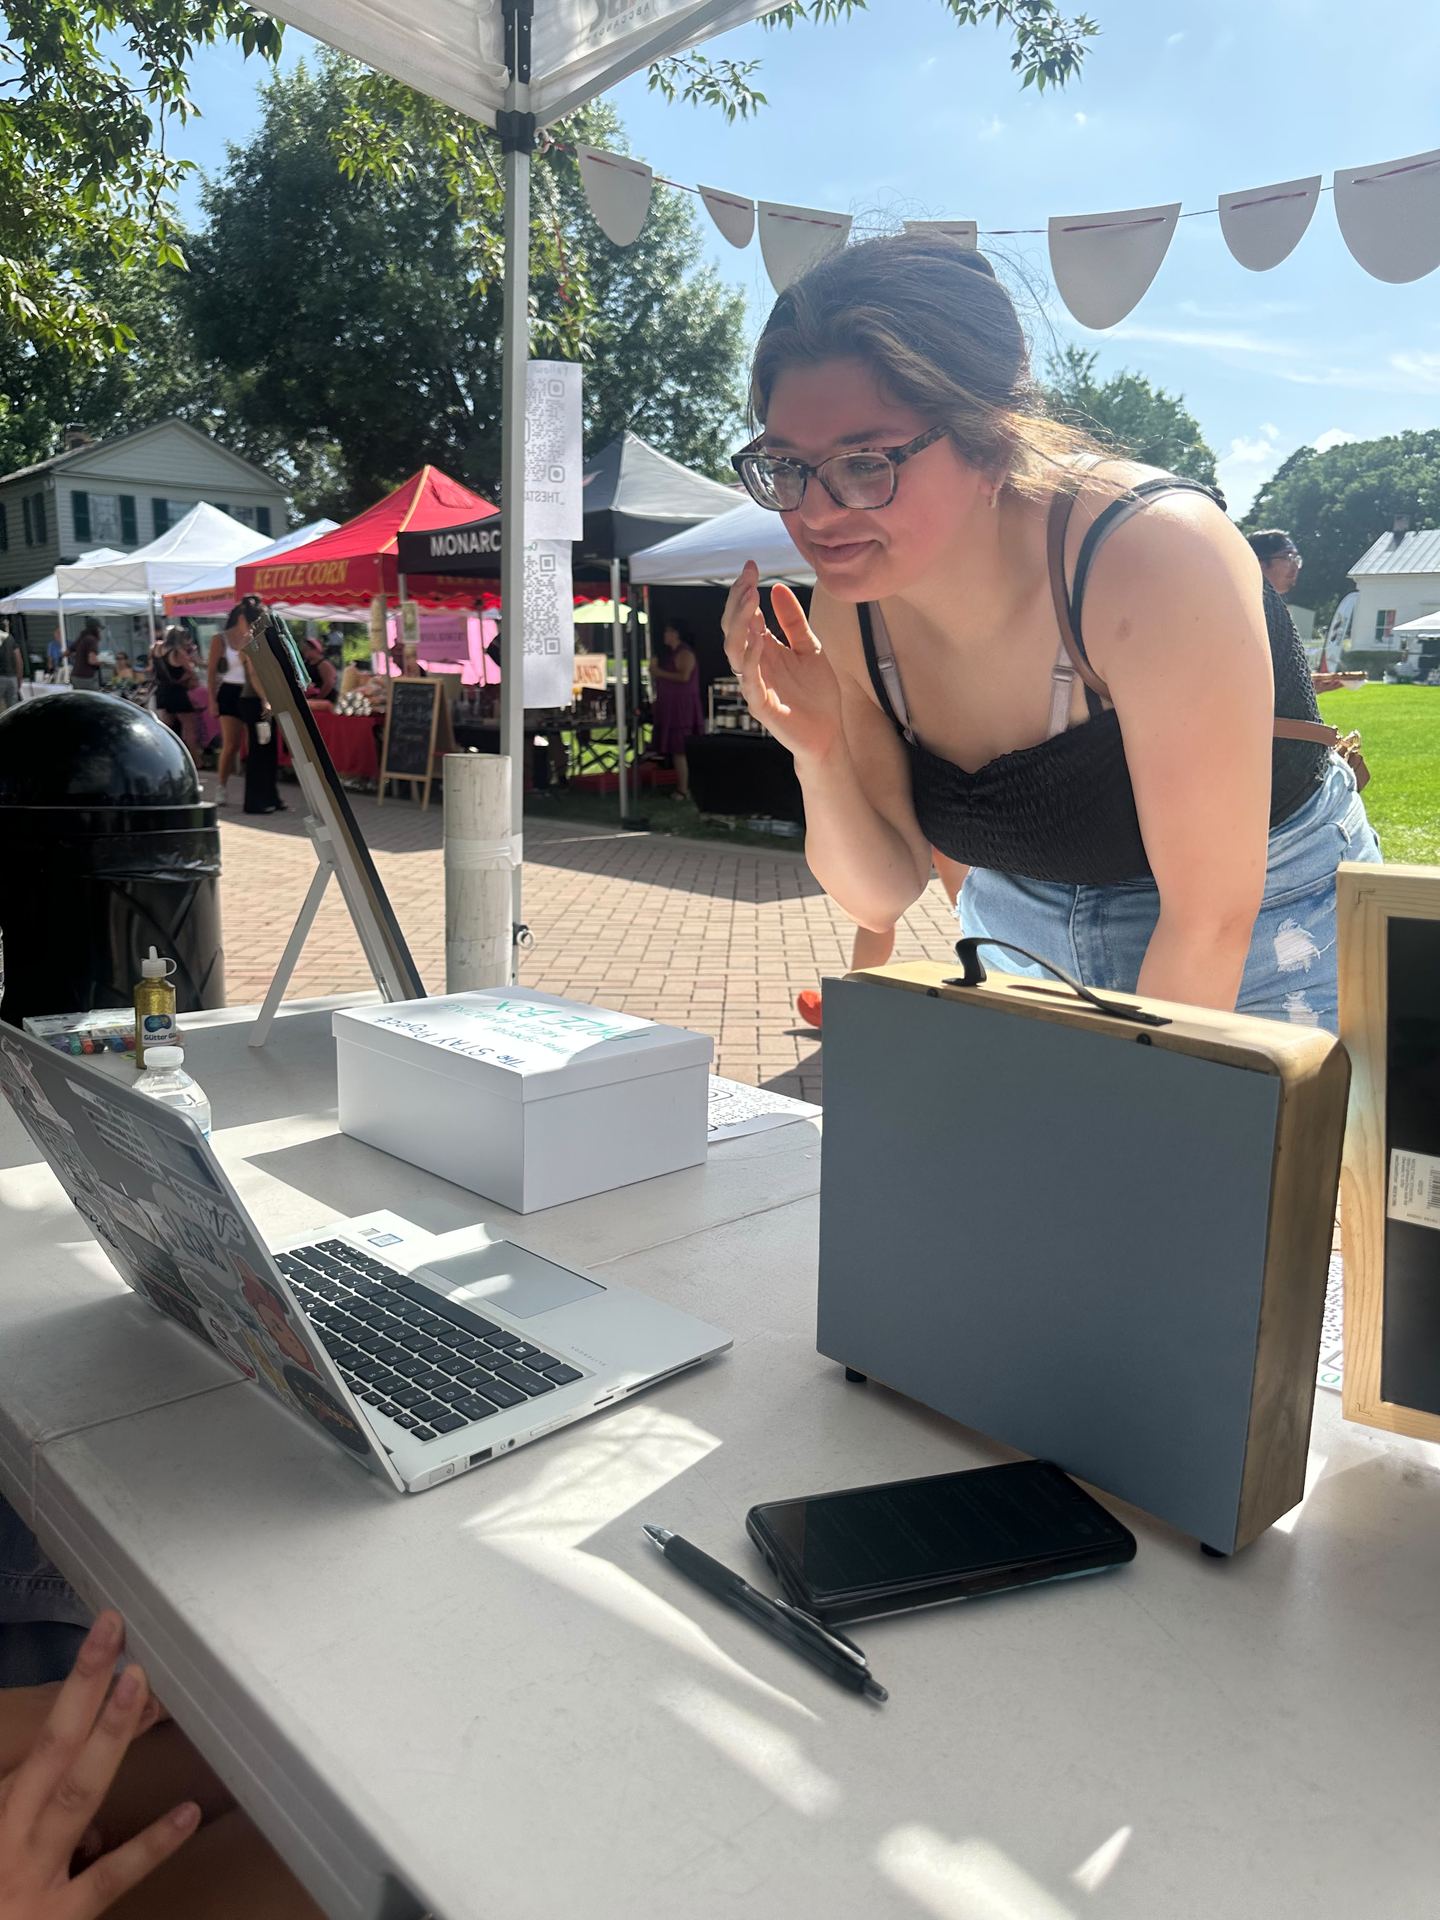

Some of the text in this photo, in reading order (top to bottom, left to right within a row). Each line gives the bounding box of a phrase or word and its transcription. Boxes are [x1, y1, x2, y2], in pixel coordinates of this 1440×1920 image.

[430, 529, 502, 557] MONARC
[254, 560, 350, 590] KETTLE CORN
[375, 1016, 438, 1039] Project
[481, 1001, 650, 1042] PRIZE BOX
[434, 1037, 496, 1057] STAY
